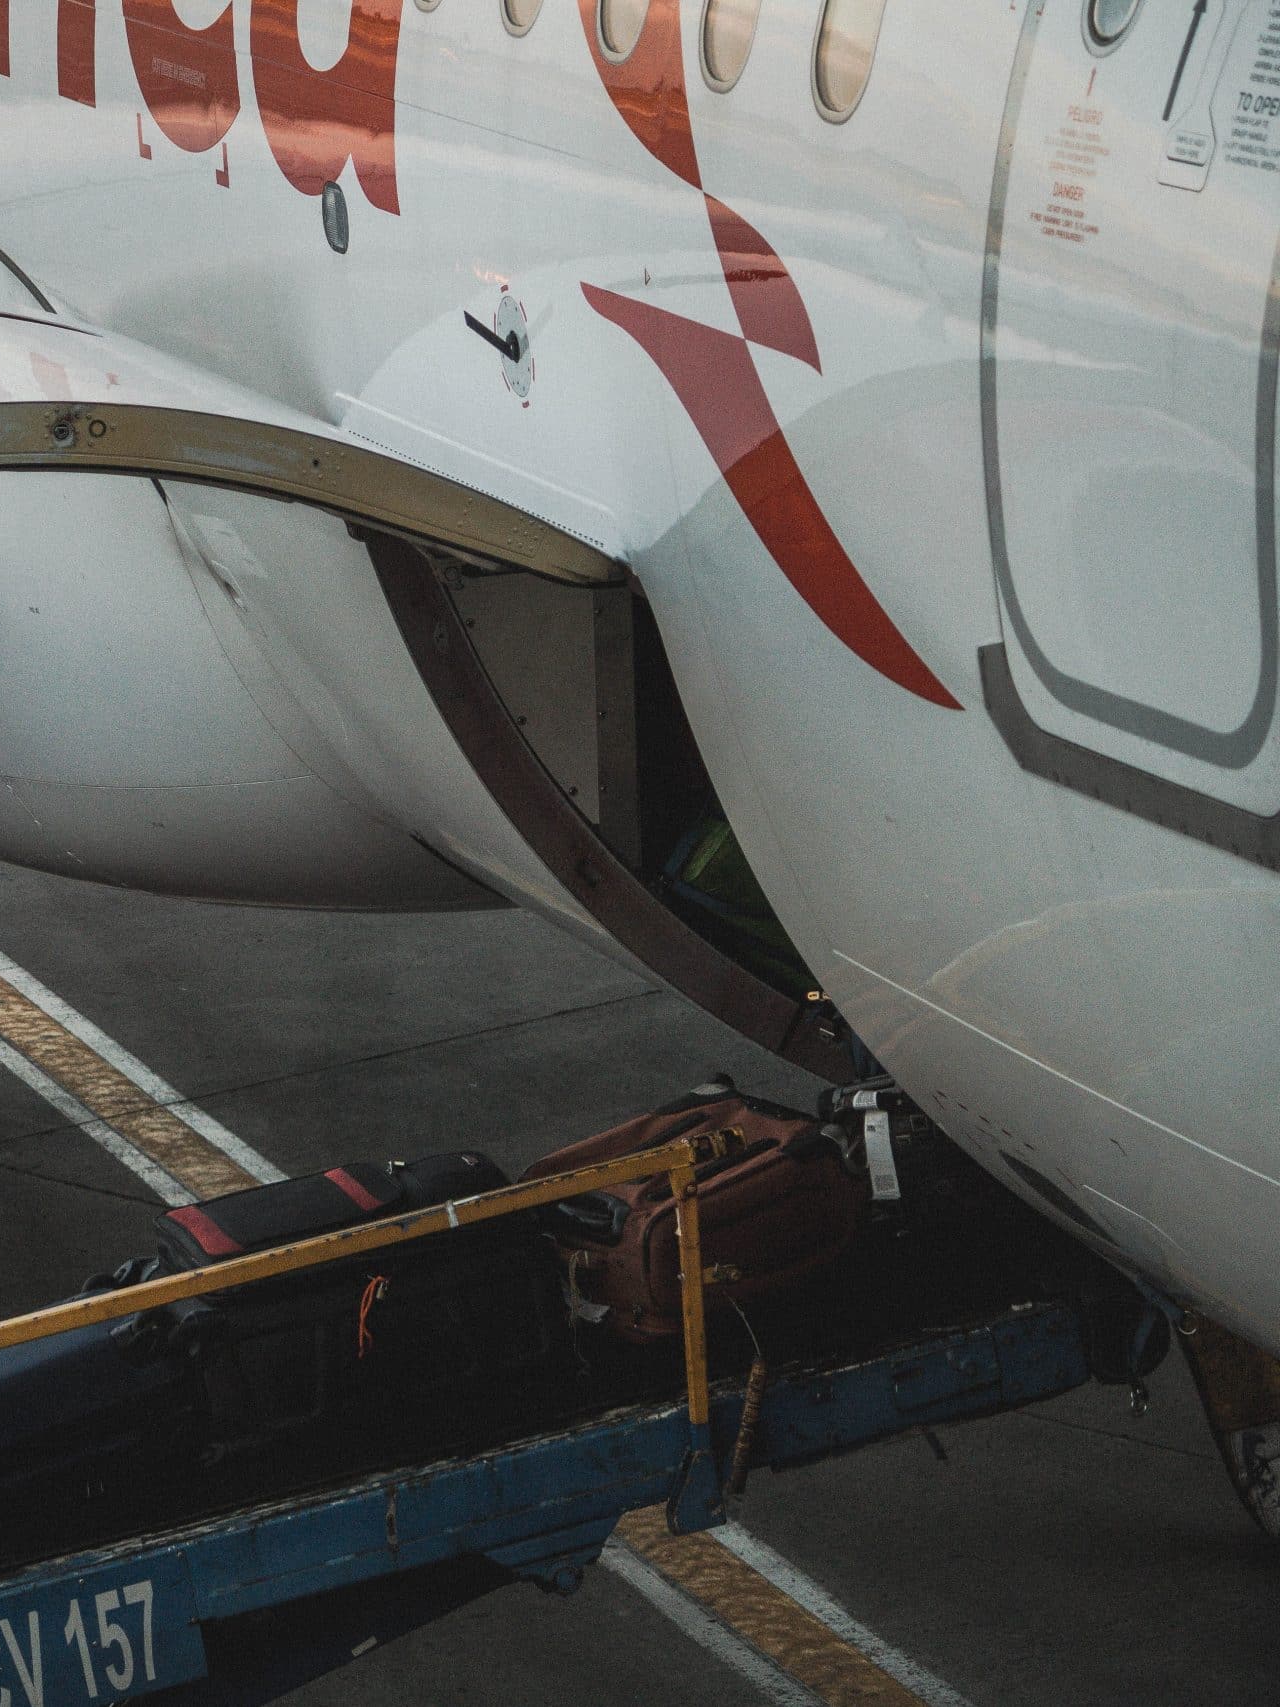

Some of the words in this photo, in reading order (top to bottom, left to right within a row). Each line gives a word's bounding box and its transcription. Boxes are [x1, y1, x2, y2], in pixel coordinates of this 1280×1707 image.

[1237, 91, 1252, 111] TO
[1254, 95, 1280, 116] OPE
[63, 1579, 157, 1698] 157
